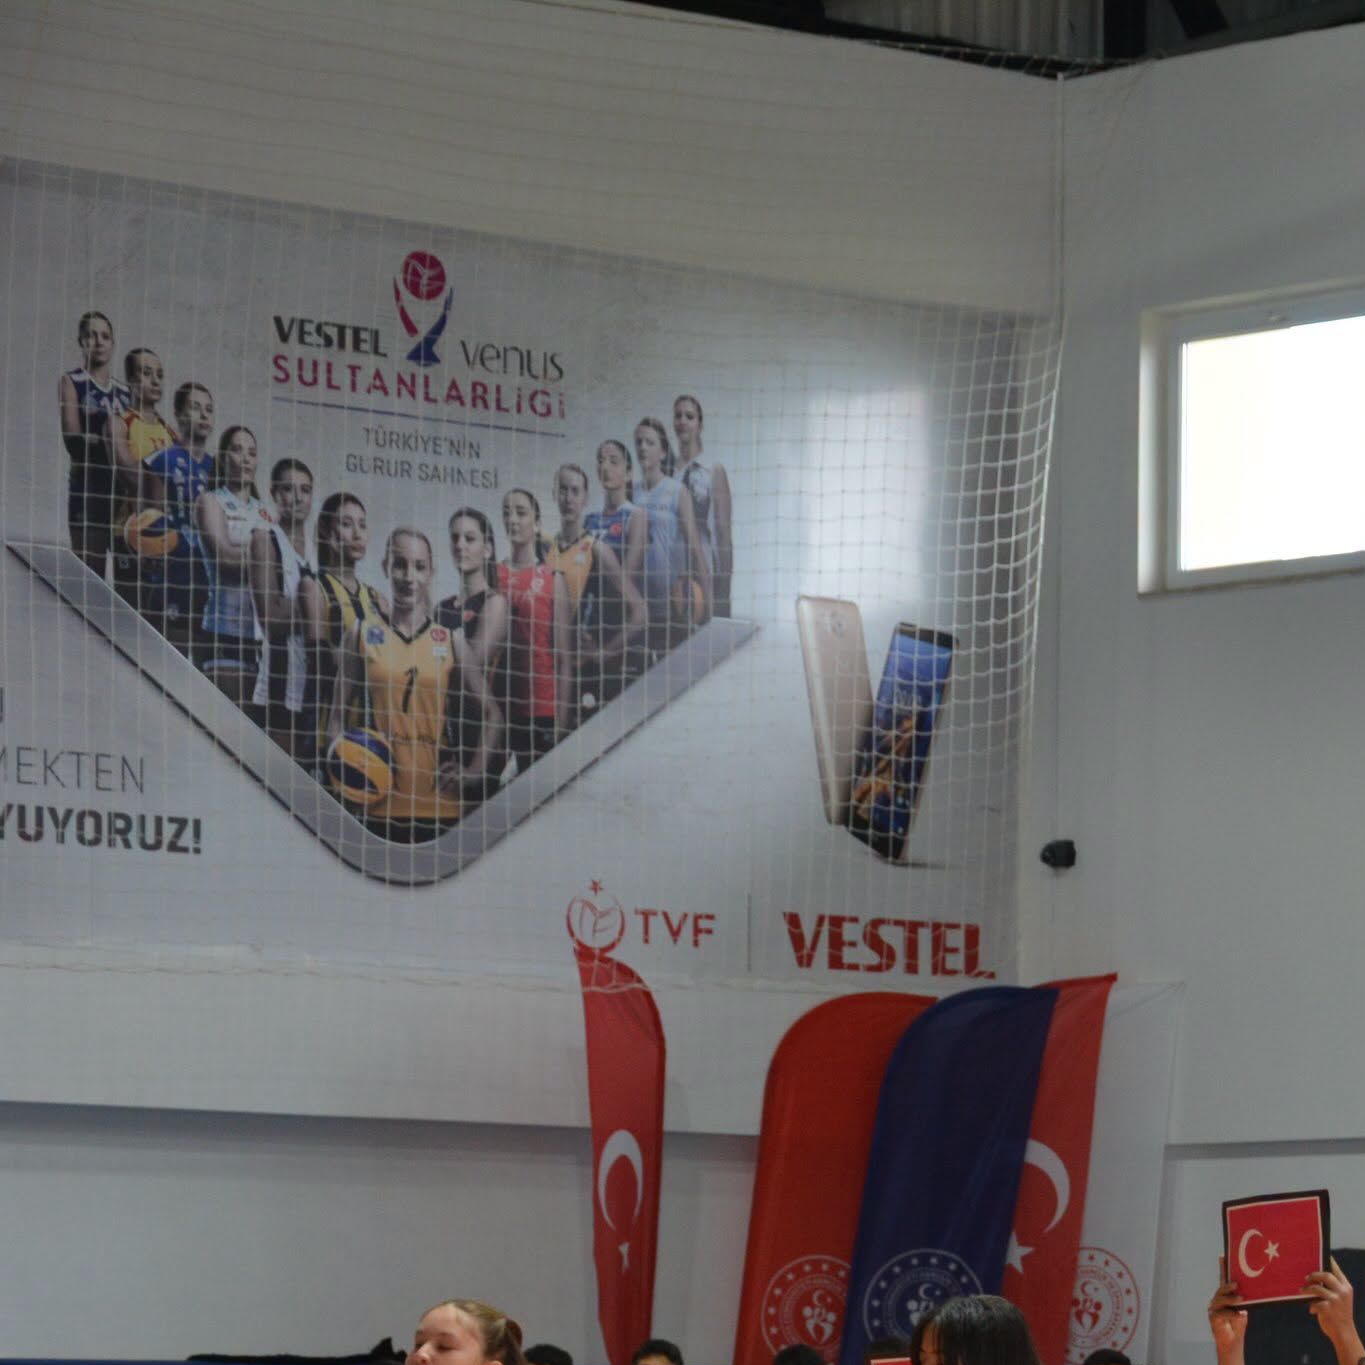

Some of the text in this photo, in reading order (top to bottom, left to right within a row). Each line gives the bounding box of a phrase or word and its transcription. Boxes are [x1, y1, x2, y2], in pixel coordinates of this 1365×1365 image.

[273, 315, 387, 358] VESTEL
[633, 908, 716, 948] TVF
[782, 911, 997, 980] VESTEL
